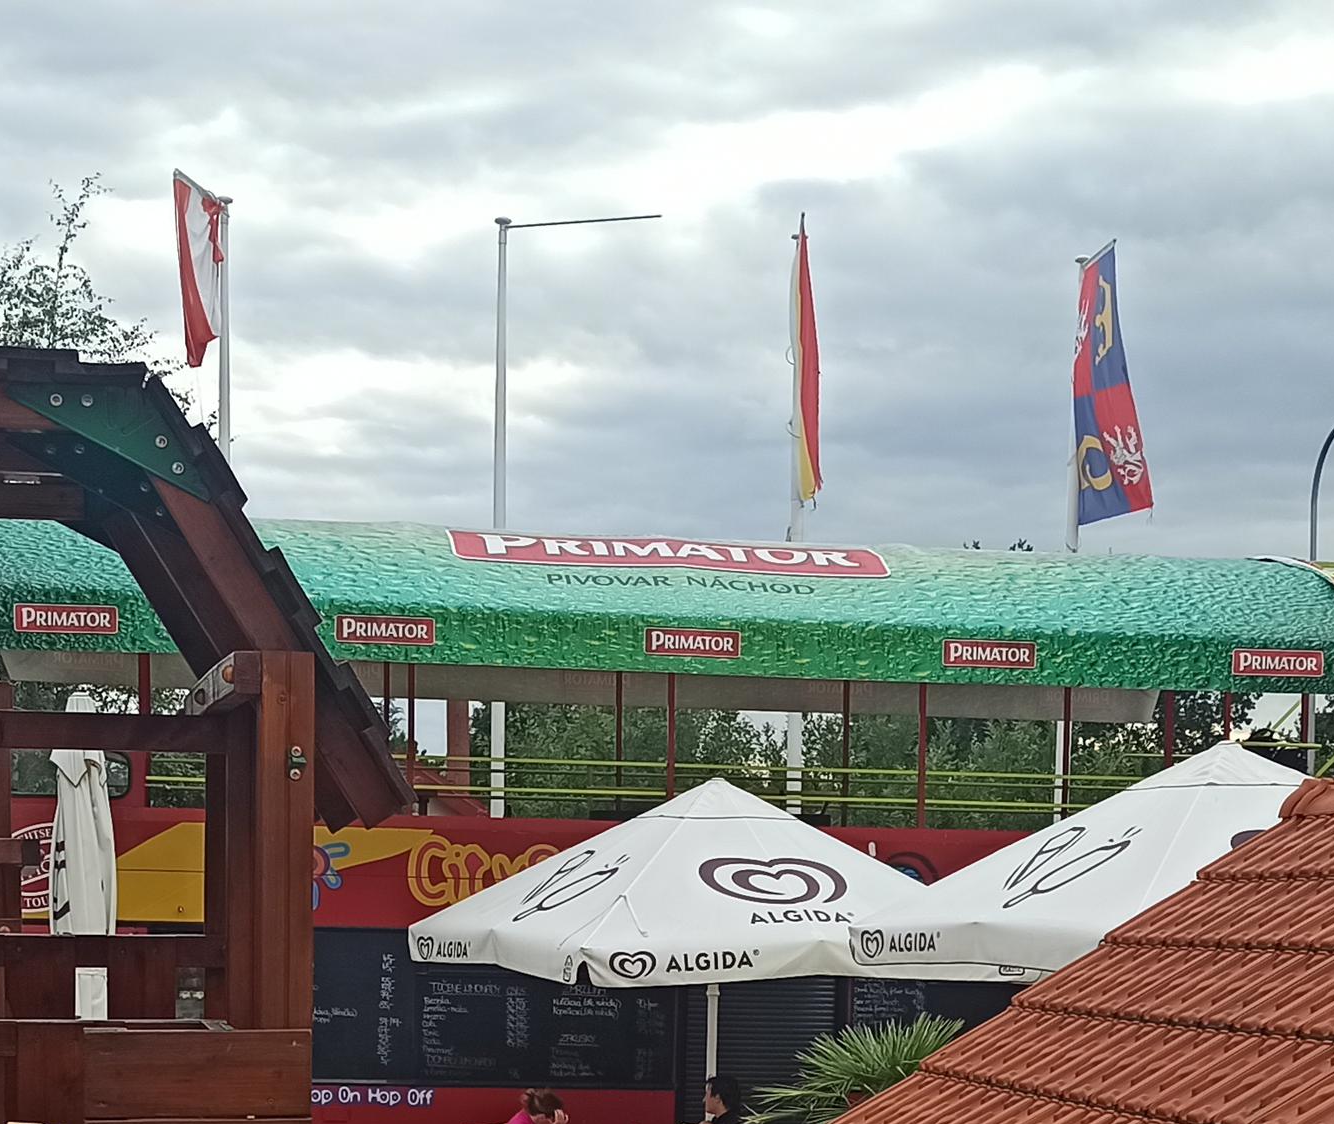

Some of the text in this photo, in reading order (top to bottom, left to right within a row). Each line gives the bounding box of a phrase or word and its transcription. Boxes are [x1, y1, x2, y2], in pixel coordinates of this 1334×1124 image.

[478, 533, 861, 567] PRIMATOR
[546, 573, 816, 595] PIVOVAR NÁCHOD
[21, 607, 111, 628] PRIMATOR
[342, 618, 429, 639] PRIMATOR
[651, 631, 734, 651] PRIMATOR
[949, 643, 1030, 663] PRIMATOR
[1238, 652, 1318, 672] PRIMATOR
[750, 909, 851, 925] ALGIDA
[436, 941, 469, 958] ALGIDA
[889, 932, 936, 952] ALGIDA
[666, 951, 754, 973] ALGIDA
[311, 1086, 434, 1106] op On Hop Off
